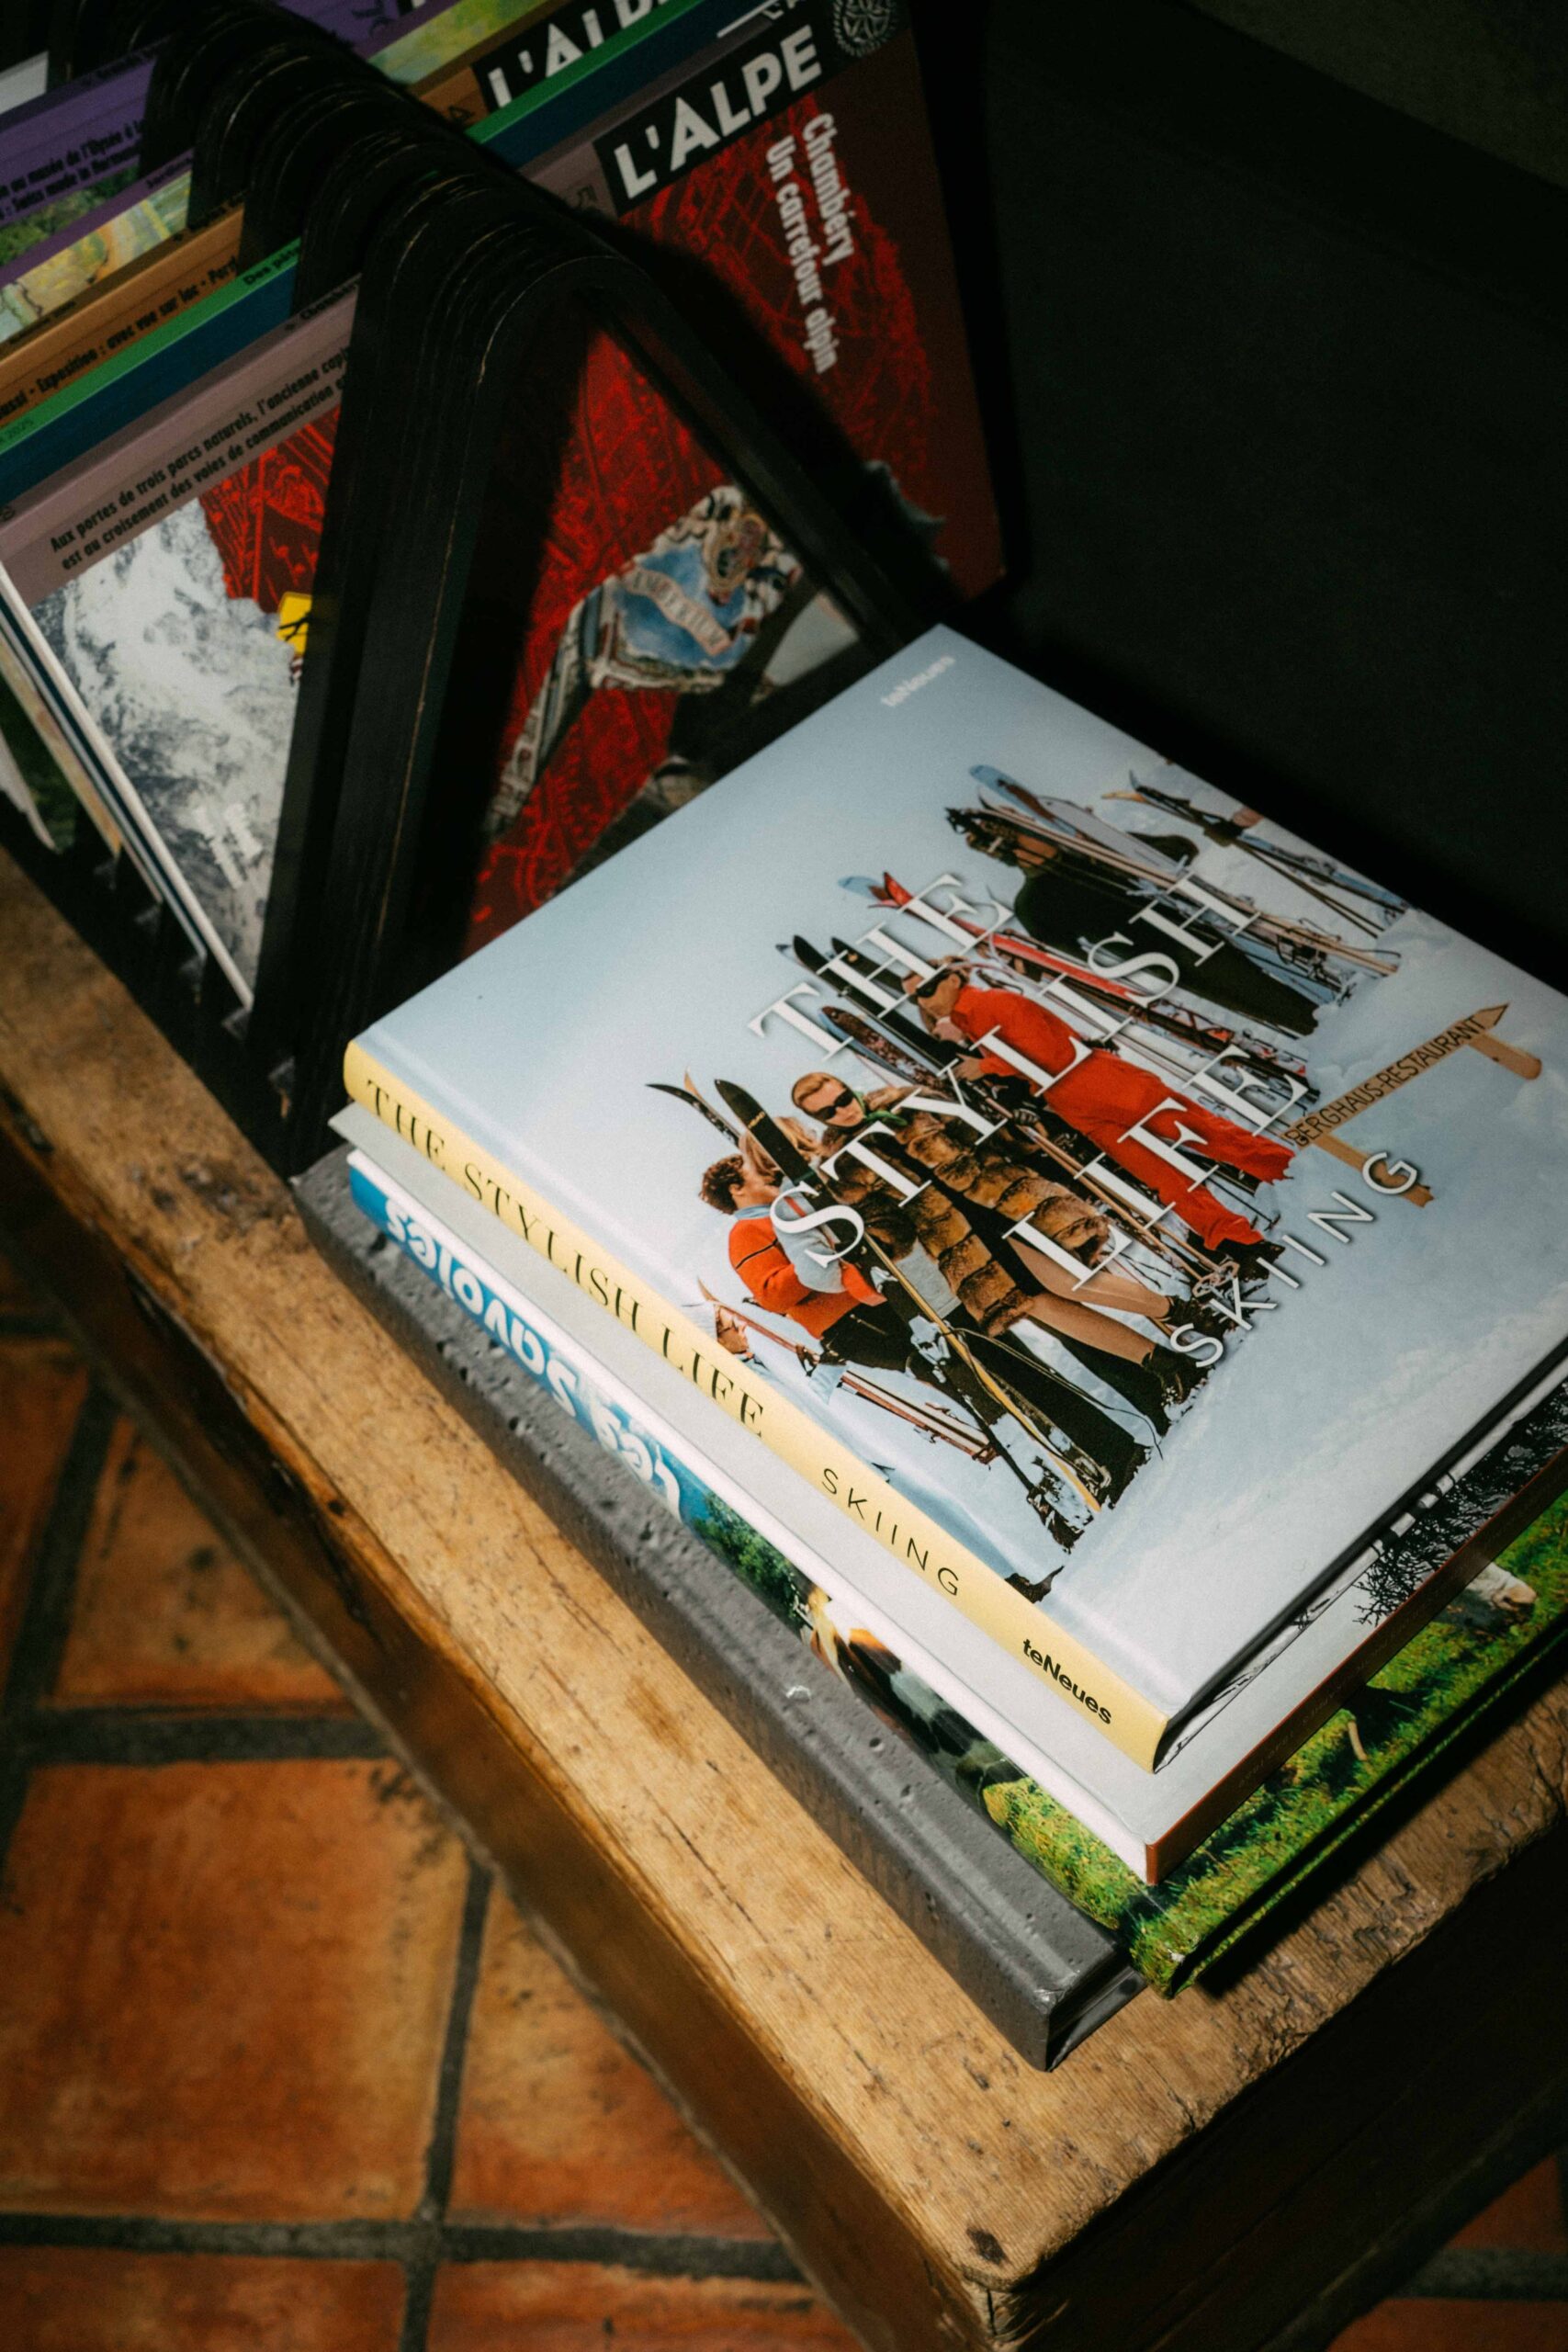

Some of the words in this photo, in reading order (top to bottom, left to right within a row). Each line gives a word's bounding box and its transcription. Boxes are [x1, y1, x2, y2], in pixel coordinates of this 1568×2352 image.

[613, 23, 823, 200] L'ALPE
[765, 134, 797, 181] Un
[802, 112, 856, 266] Chambéry
[107, 325, 135, 348] avec
[159, 297, 177, 316] sur
[775, 181, 823, 307] carrefour
[803, 308, 839, 375] alpin
[51, 530, 75, 552] Aux
[76, 503, 118, 538] portes
[118, 490, 135, 506] de
[136, 470, 165, 494] trois
[167, 446, 202, 477] parcs
[203, 413, 258, 451] naturels,
[257, 368, 319, 415] l'ancienne
[62, 550, 82, 570] est
[84, 539, 101, 555] au
[102, 493, 169, 543] croisement
[171, 479, 192, 499] des
[194, 457, 226, 482] voies
[229, 445, 243, 460] de
[245, 386, 334, 449] communication
[748, 874, 1014, 1060] THE
[769, 867, 1263, 1268] STYLISH
[1002, 1044, 1309, 1291] LIFE
[1169, 1151, 1418, 1368] SKIING
[385, 1197, 581, 1418] Savoies
[367, 1080, 446, 1171] THE
[464, 1162, 643, 1332] STYLISH
[661, 1322, 764, 1438] LIFE
[820, 1467, 961, 1597] SKIING
[1022, 1638, 1112, 1724] teNeues
